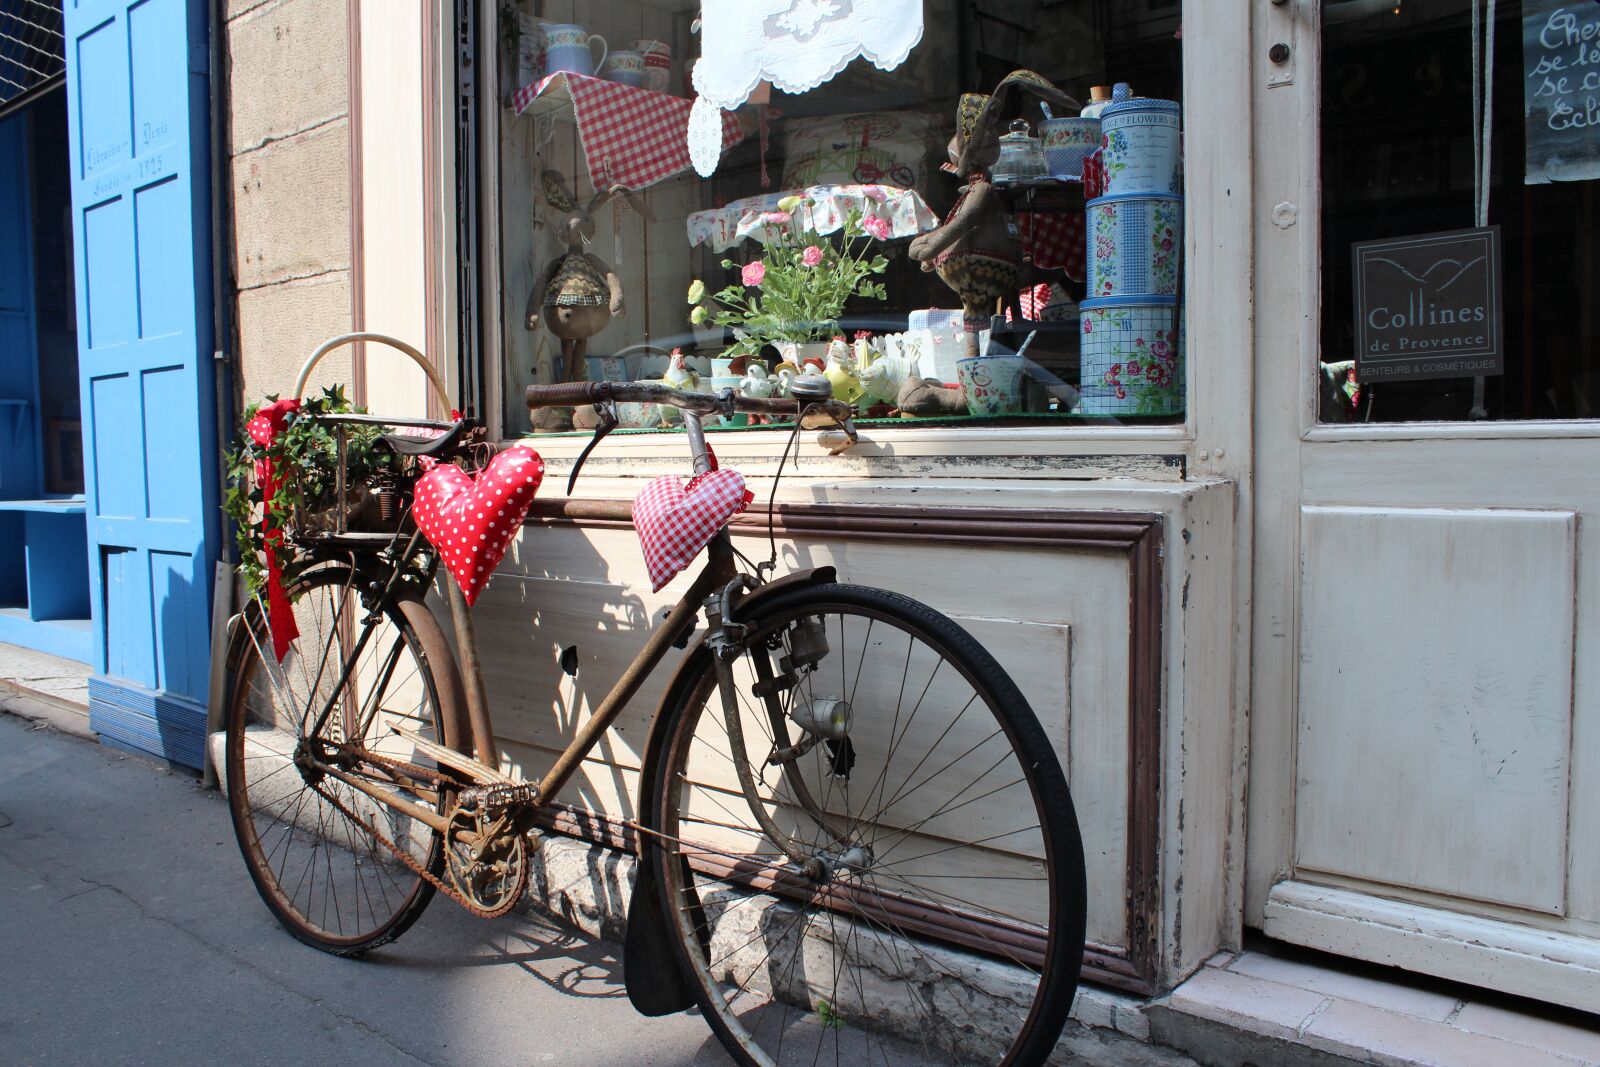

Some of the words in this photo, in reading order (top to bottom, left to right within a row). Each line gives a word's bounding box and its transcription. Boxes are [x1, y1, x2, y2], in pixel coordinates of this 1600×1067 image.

[1368, 287, 1485, 330] Collines
[1370, 339, 1390, 352] de
[1399, 336, 1485, 350] Provence
[1360, 366, 1411, 377] SENTEURS
